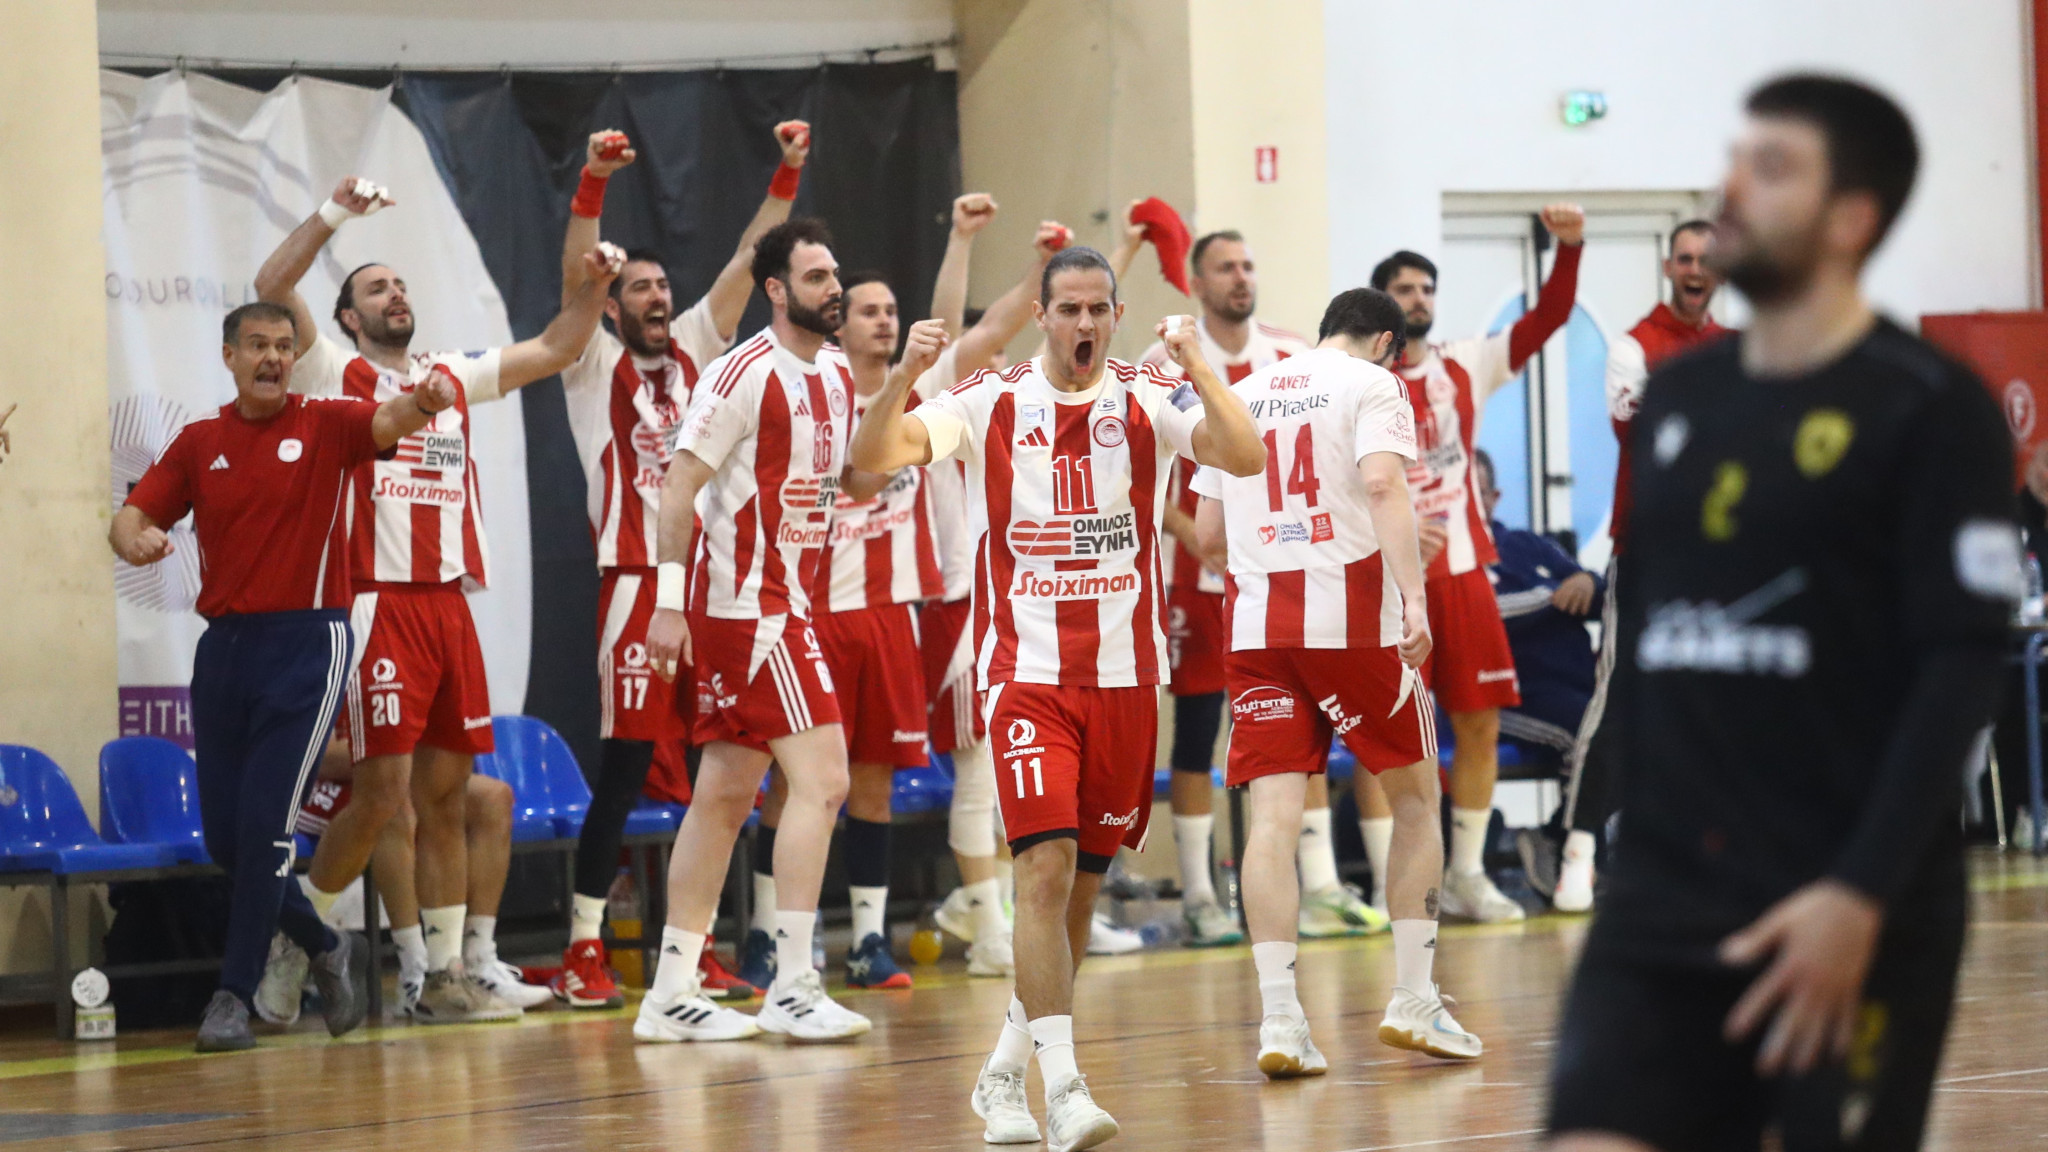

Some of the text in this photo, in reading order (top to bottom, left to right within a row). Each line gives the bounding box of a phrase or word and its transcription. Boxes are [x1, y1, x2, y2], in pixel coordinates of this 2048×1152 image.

[1268, 394, 1329, 417] Piraeus
[1262, 422, 1320, 512] 14
[376, 477, 462, 502] Stoiximan
[1052, 455, 1099, 513] 11
[1075, 529, 1134, 554] ΞΥΝΗ
[1014, 571, 1135, 597] Stoiximan
[622, 677, 649, 710] 17
[1234, 697, 1294, 713] buythemile
[372, 692, 400, 727] 20
[1011, 757, 1044, 798] 11
